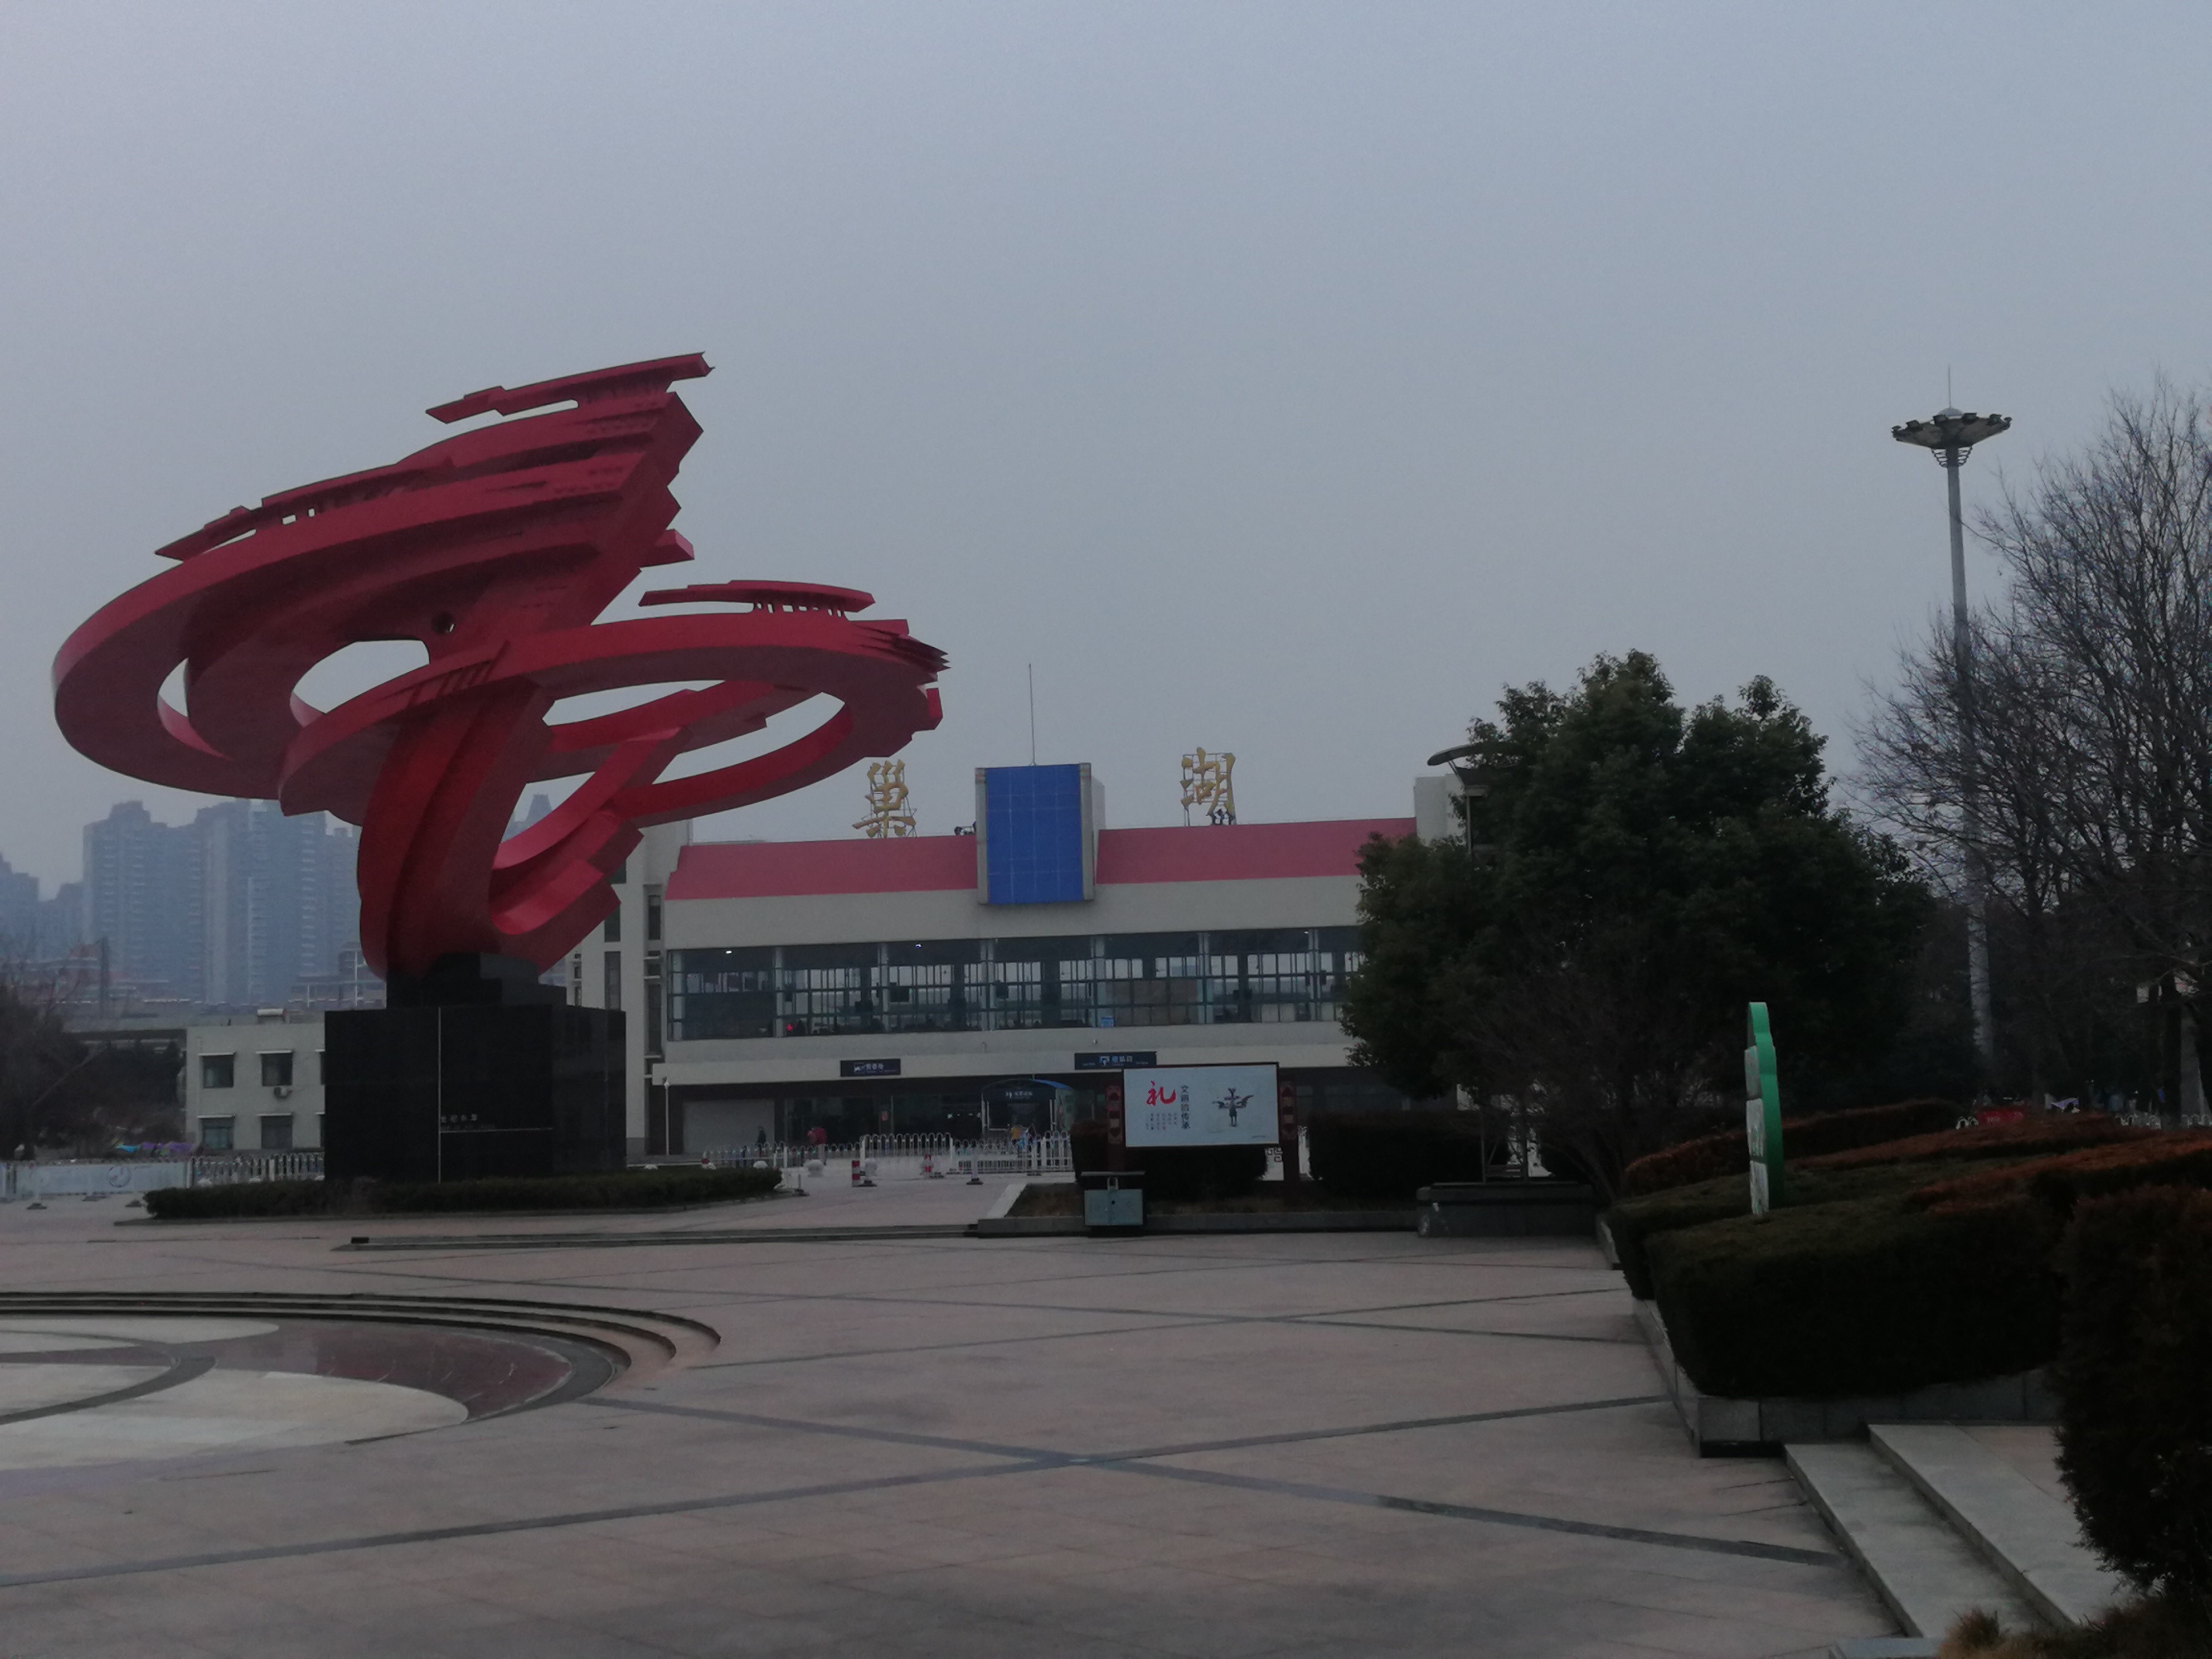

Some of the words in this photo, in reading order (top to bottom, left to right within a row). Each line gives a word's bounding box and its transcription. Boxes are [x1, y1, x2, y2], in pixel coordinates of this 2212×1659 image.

[852, 759, 916, 838] 巢
[1180, 746, 1236, 823] 湖
[1146, 1080, 1177, 1107] 礼
